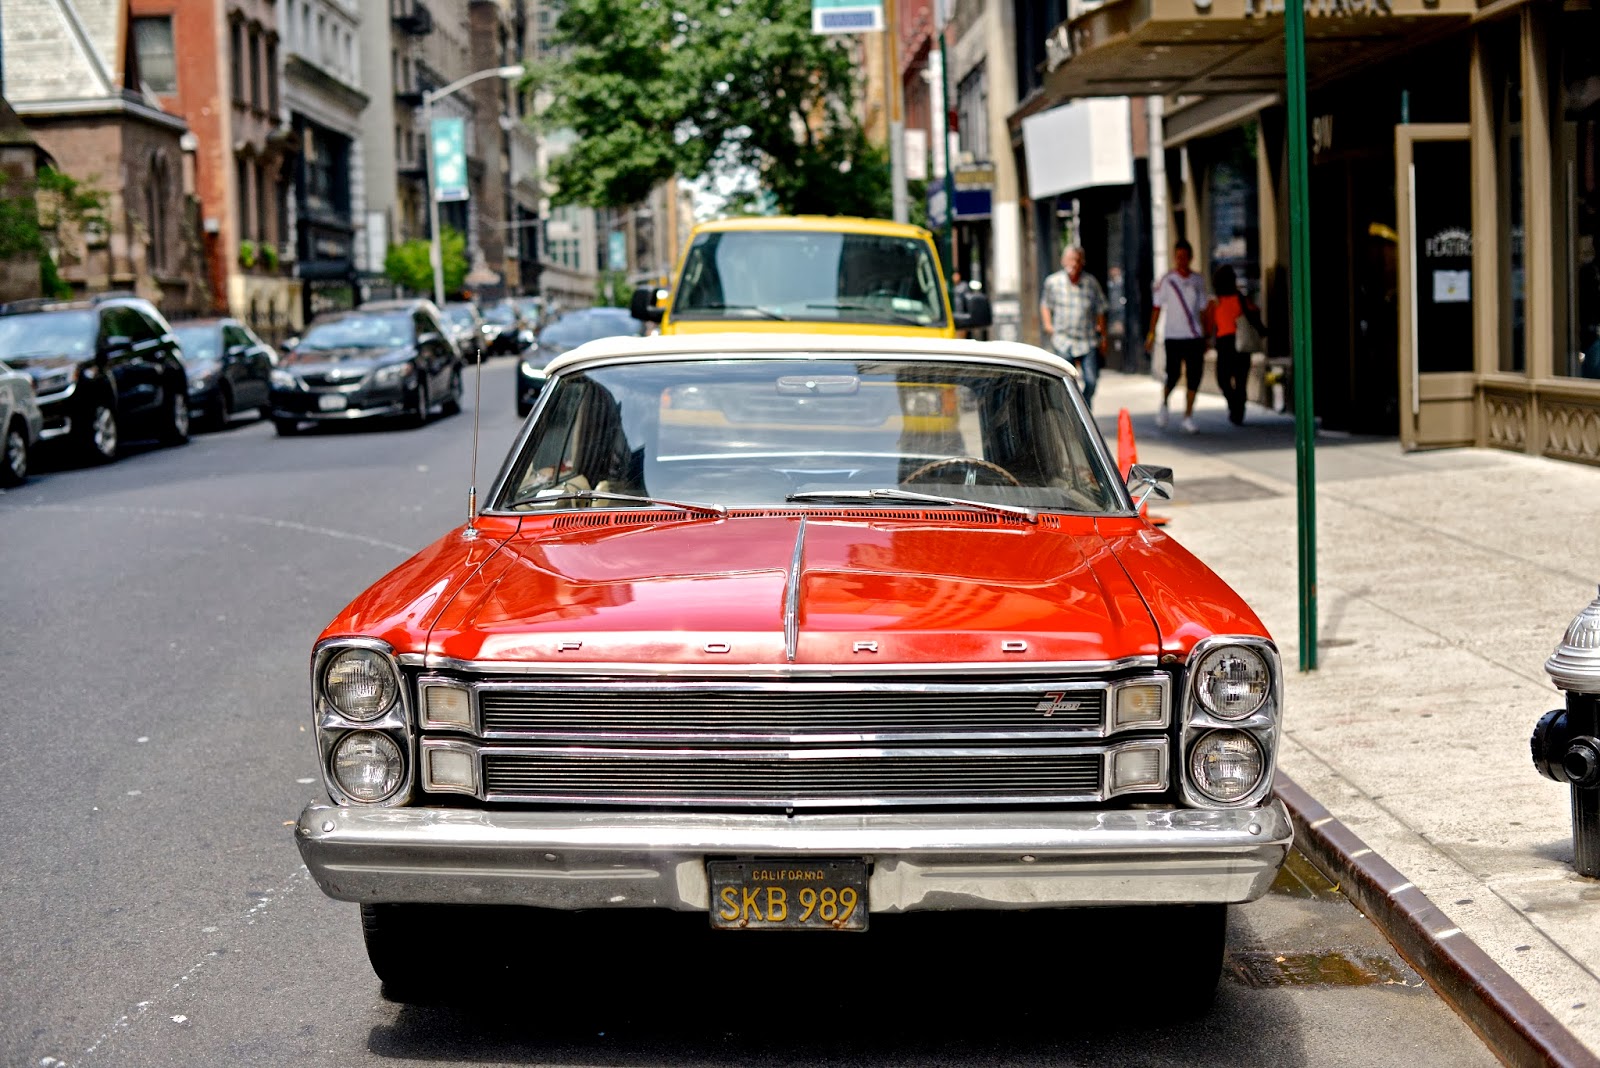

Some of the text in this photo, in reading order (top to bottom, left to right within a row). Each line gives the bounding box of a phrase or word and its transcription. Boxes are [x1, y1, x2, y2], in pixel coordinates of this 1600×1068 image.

[558, 640, 1028, 653] FORD
[752, 870, 824, 881] CALIFORNIA
[720, 886, 858, 922] SKB 989
